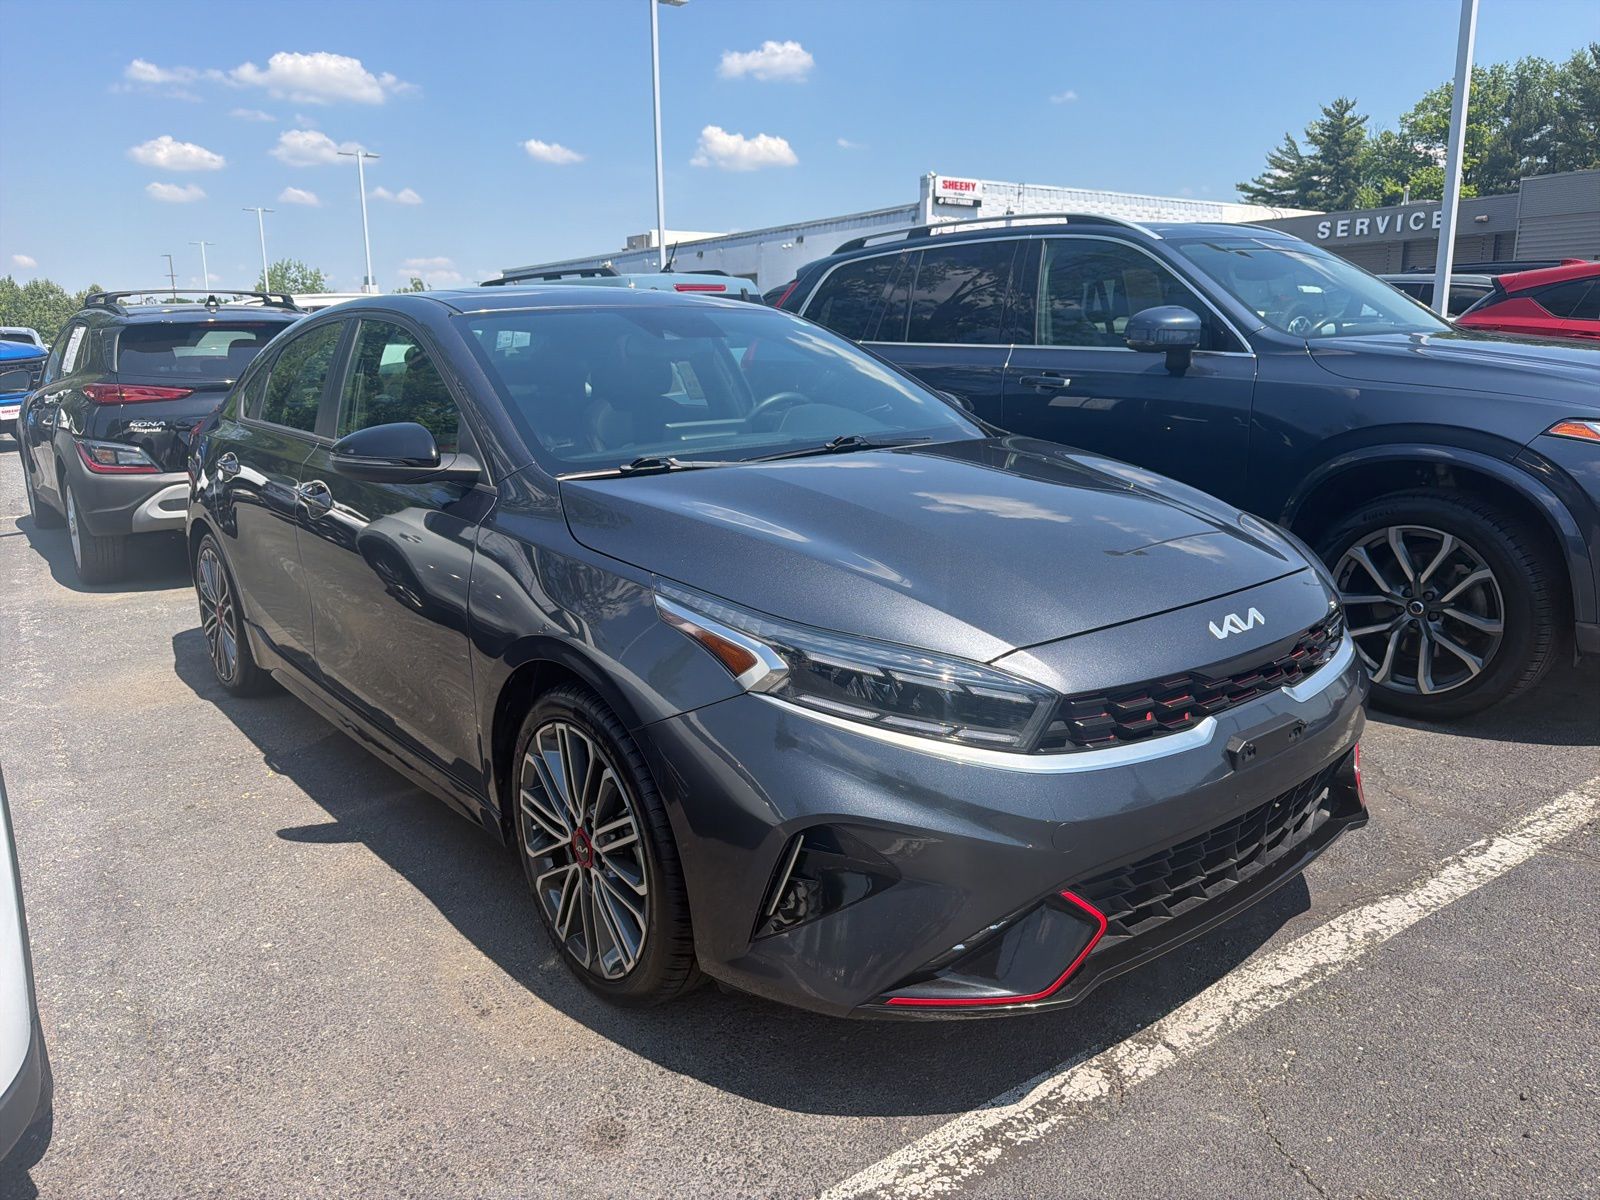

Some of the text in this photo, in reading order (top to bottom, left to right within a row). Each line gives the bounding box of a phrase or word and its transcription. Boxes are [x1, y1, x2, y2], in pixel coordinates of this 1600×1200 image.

[942, 180, 977, 192] SHEEHY
[1317, 211, 1442, 239] SERVICE
[1208, 607, 1265, 640] KIA
